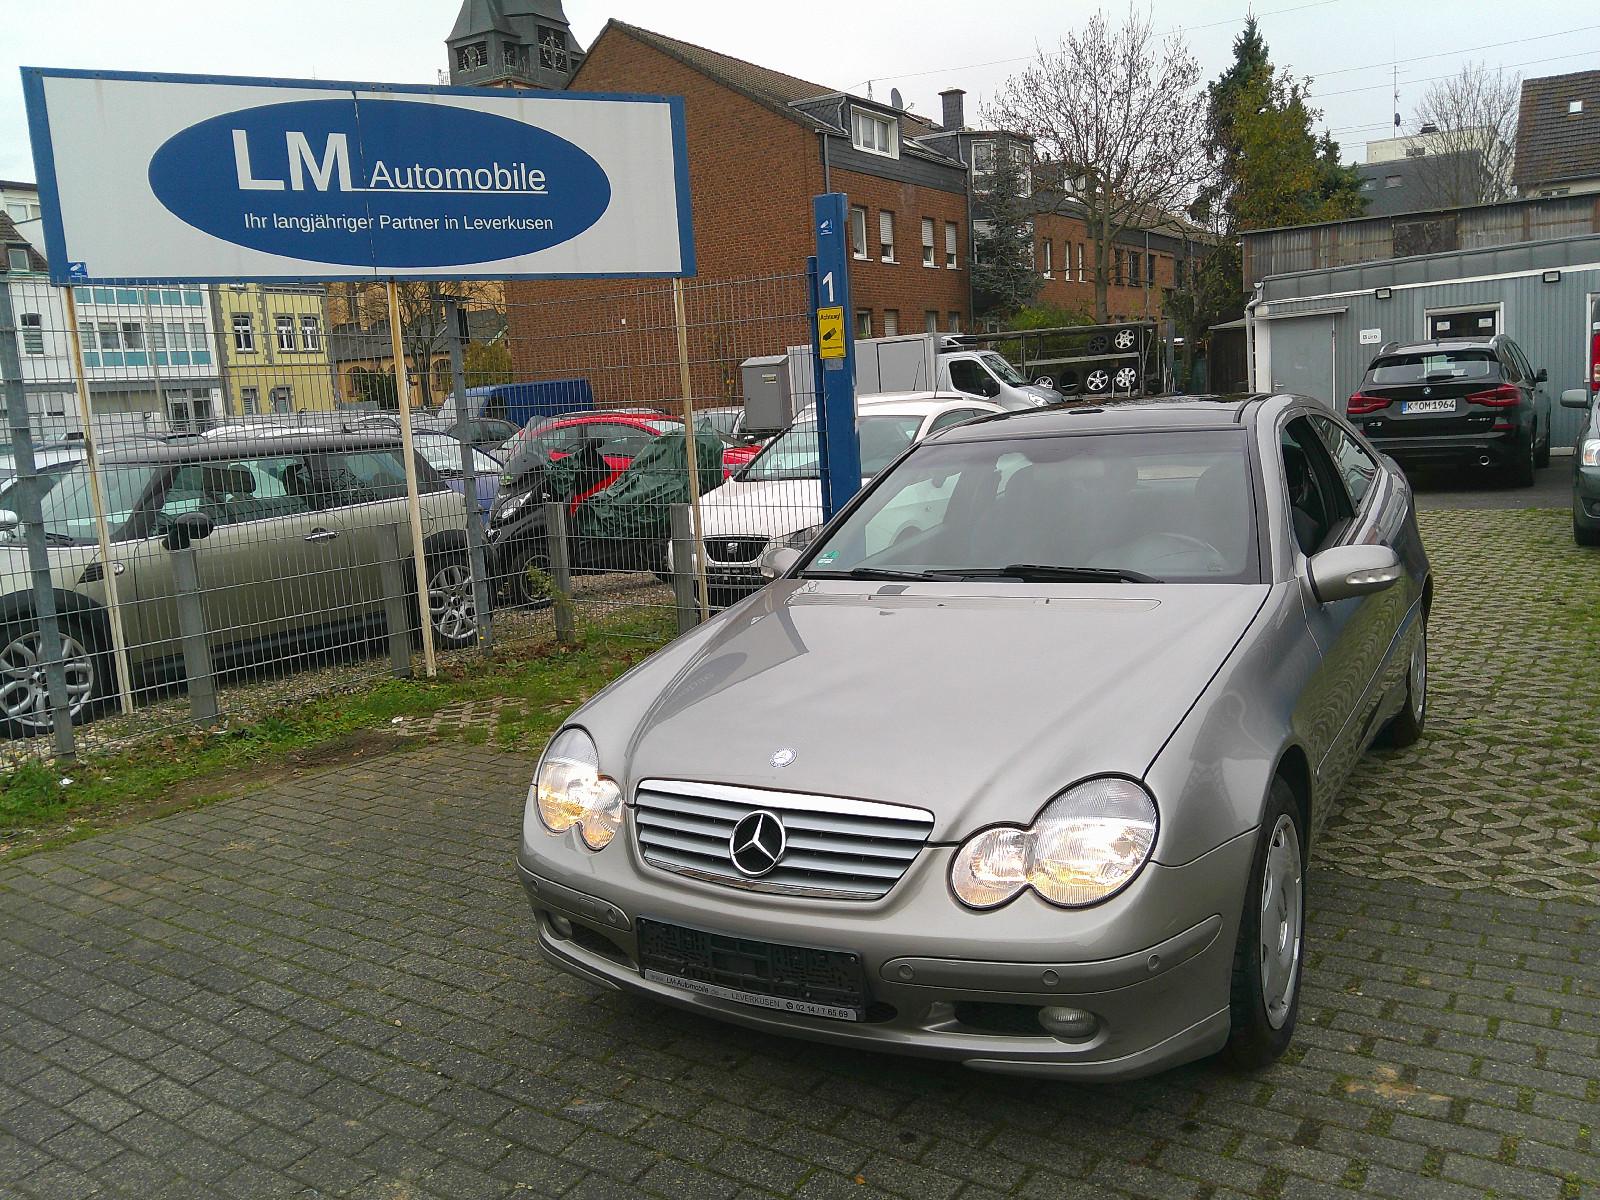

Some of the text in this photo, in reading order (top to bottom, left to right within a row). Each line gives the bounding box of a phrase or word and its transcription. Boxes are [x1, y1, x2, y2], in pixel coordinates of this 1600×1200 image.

[232, 129, 546, 192] LM Automobile
[244, 213, 554, 233] Ihr langjähriger Partner in Leverkusen
[822, 271, 834, 302] 1
[731, 992, 780, 1008] LEVERKUSEN
